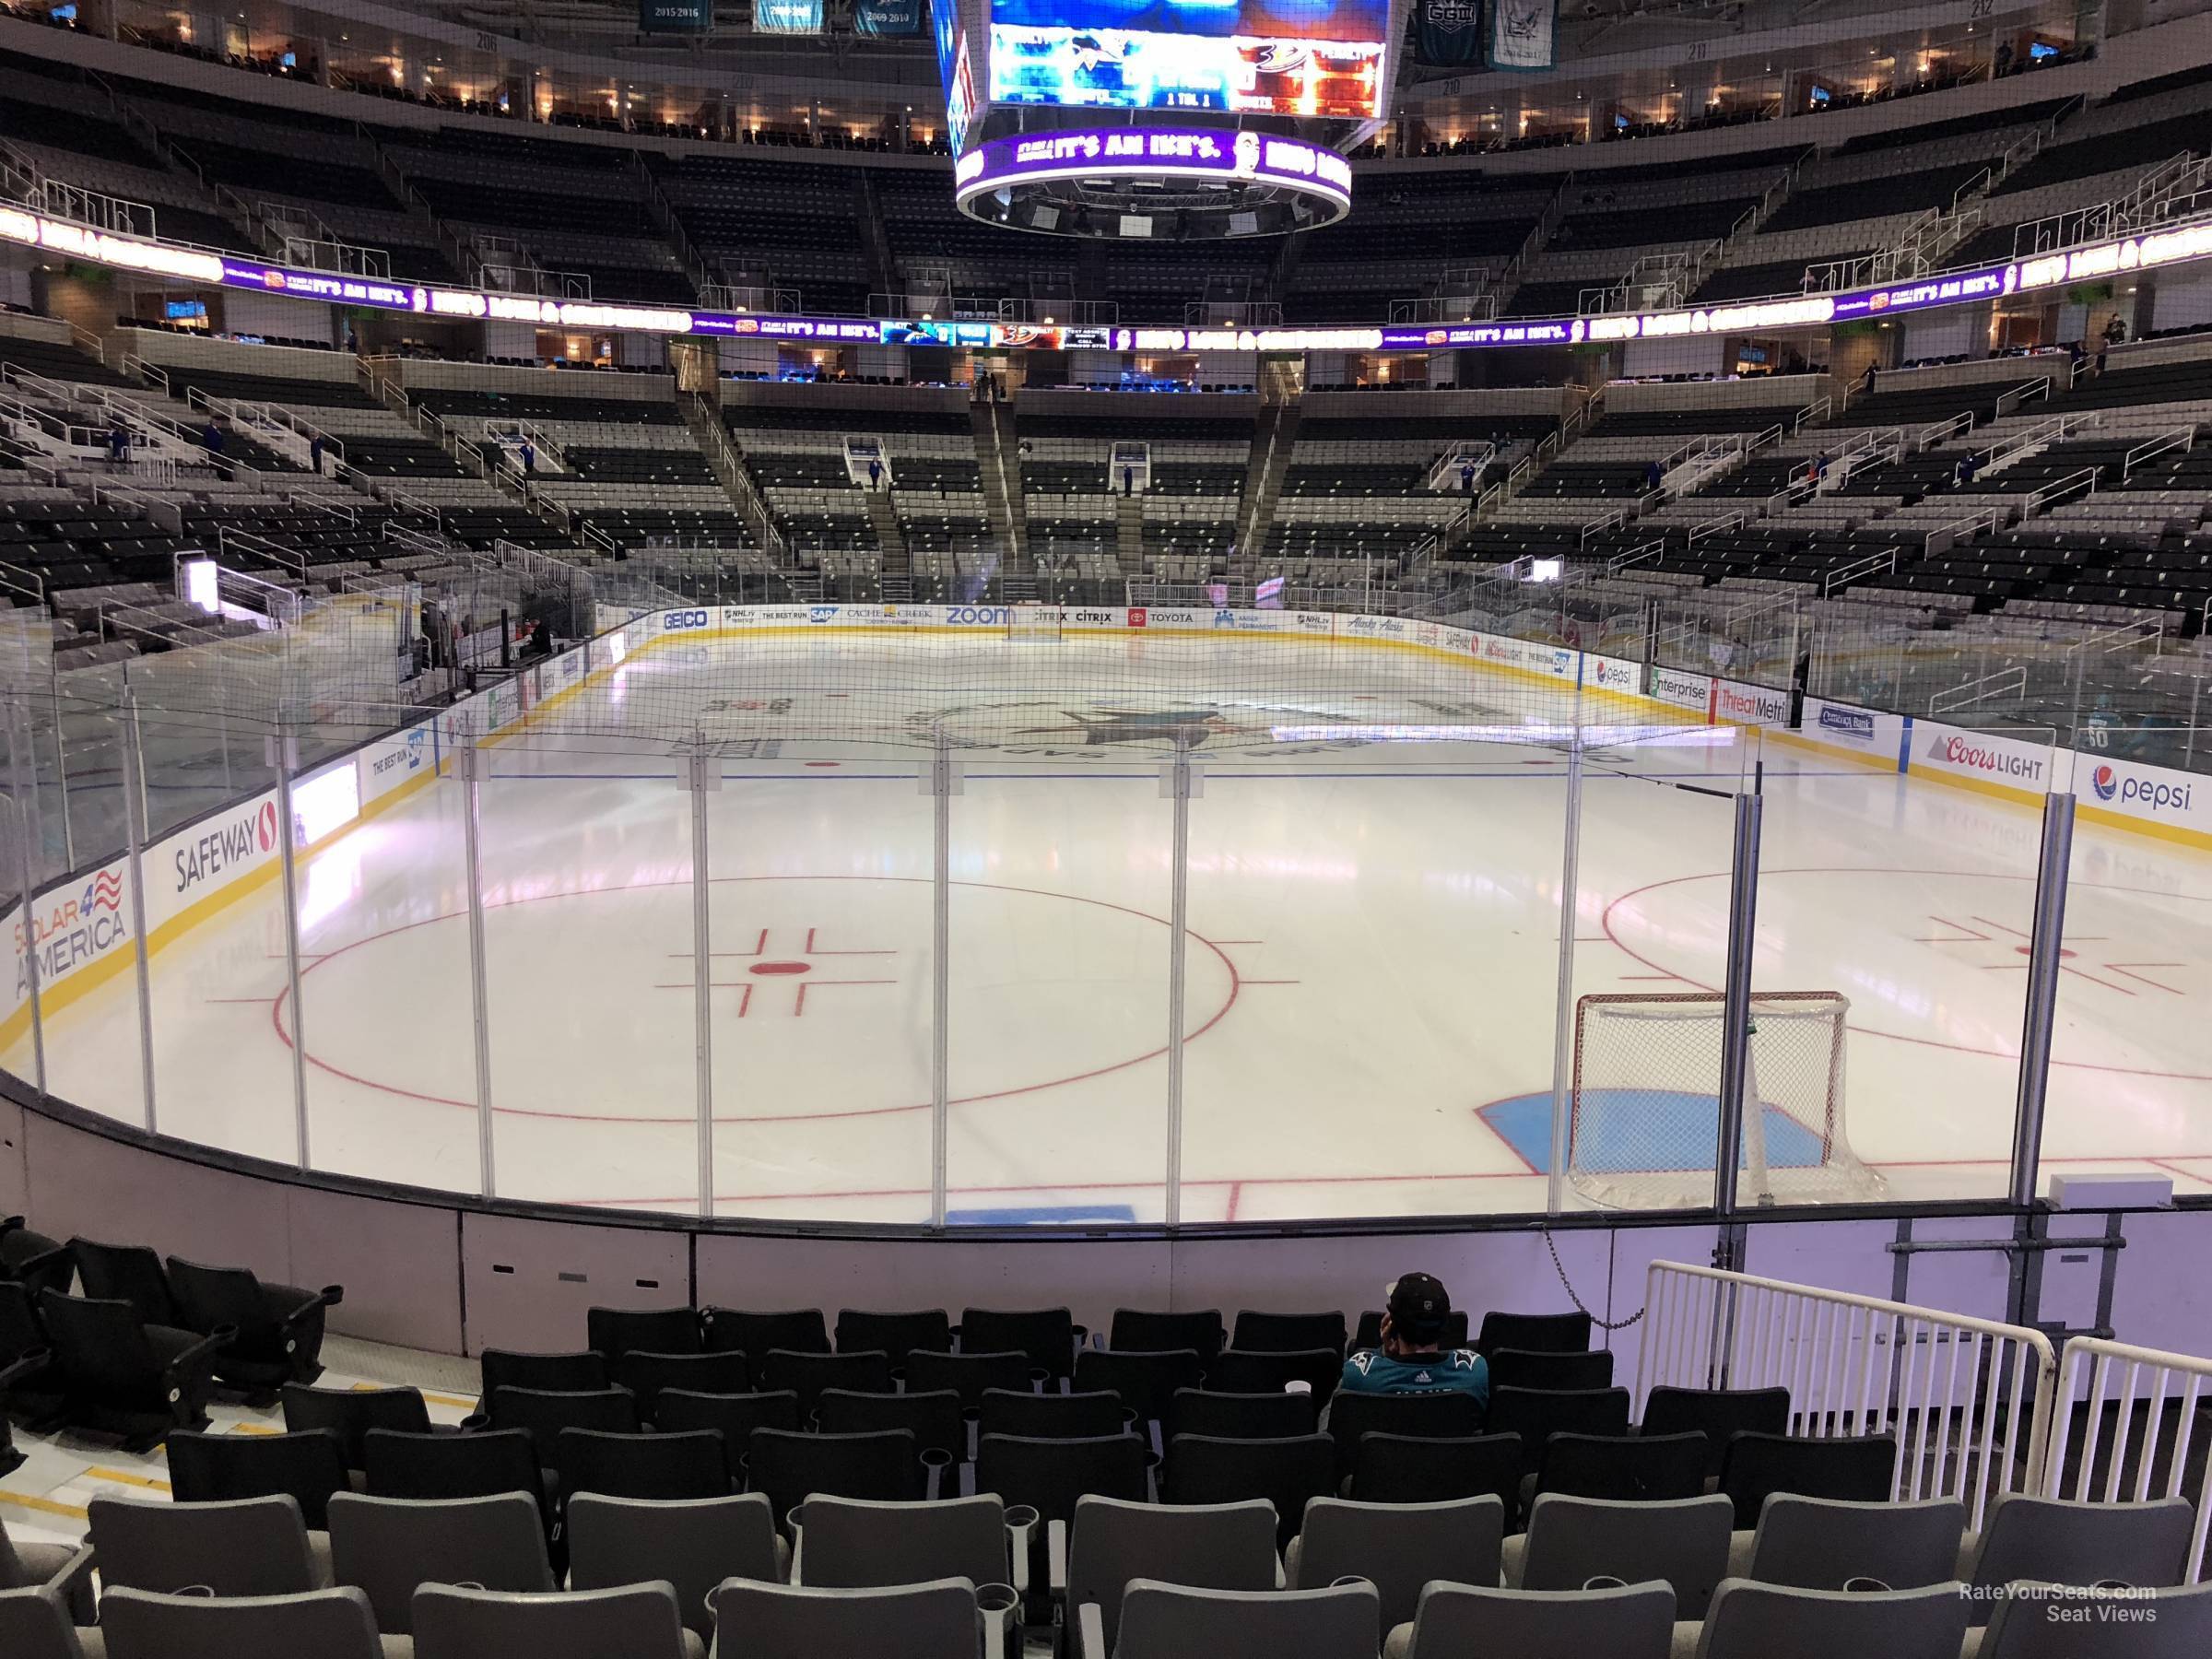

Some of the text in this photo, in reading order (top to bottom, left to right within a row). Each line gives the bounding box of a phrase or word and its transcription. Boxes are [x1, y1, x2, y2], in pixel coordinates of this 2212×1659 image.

[664, 610, 708, 630] GEICO
[812, 609, 832, 619] SAP
[1151, 613, 1194, 623] TOYOTA
[1347, 616, 1377, 629] Alaska
[1445, 631, 1472, 649] SAFEWAY
[1553, 654, 1569, 670] SAP
[1606, 666, 1630, 688] pepsi
[1651, 676, 1706, 700] enterprise
[1722, 688, 1786, 723] ThreatMetri
[1853, 715, 1871, 730] Bank
[372, 749, 407, 776] THE BEST RUN
[1946, 735, 2043, 782] Coors LIGHT
[2121, 776, 2192, 811] pepsi
[175, 815, 256, 893] SAFEWAY
[14, 899, 79, 955] SOLAR
[16, 910, 126, 1000] AMERICA
